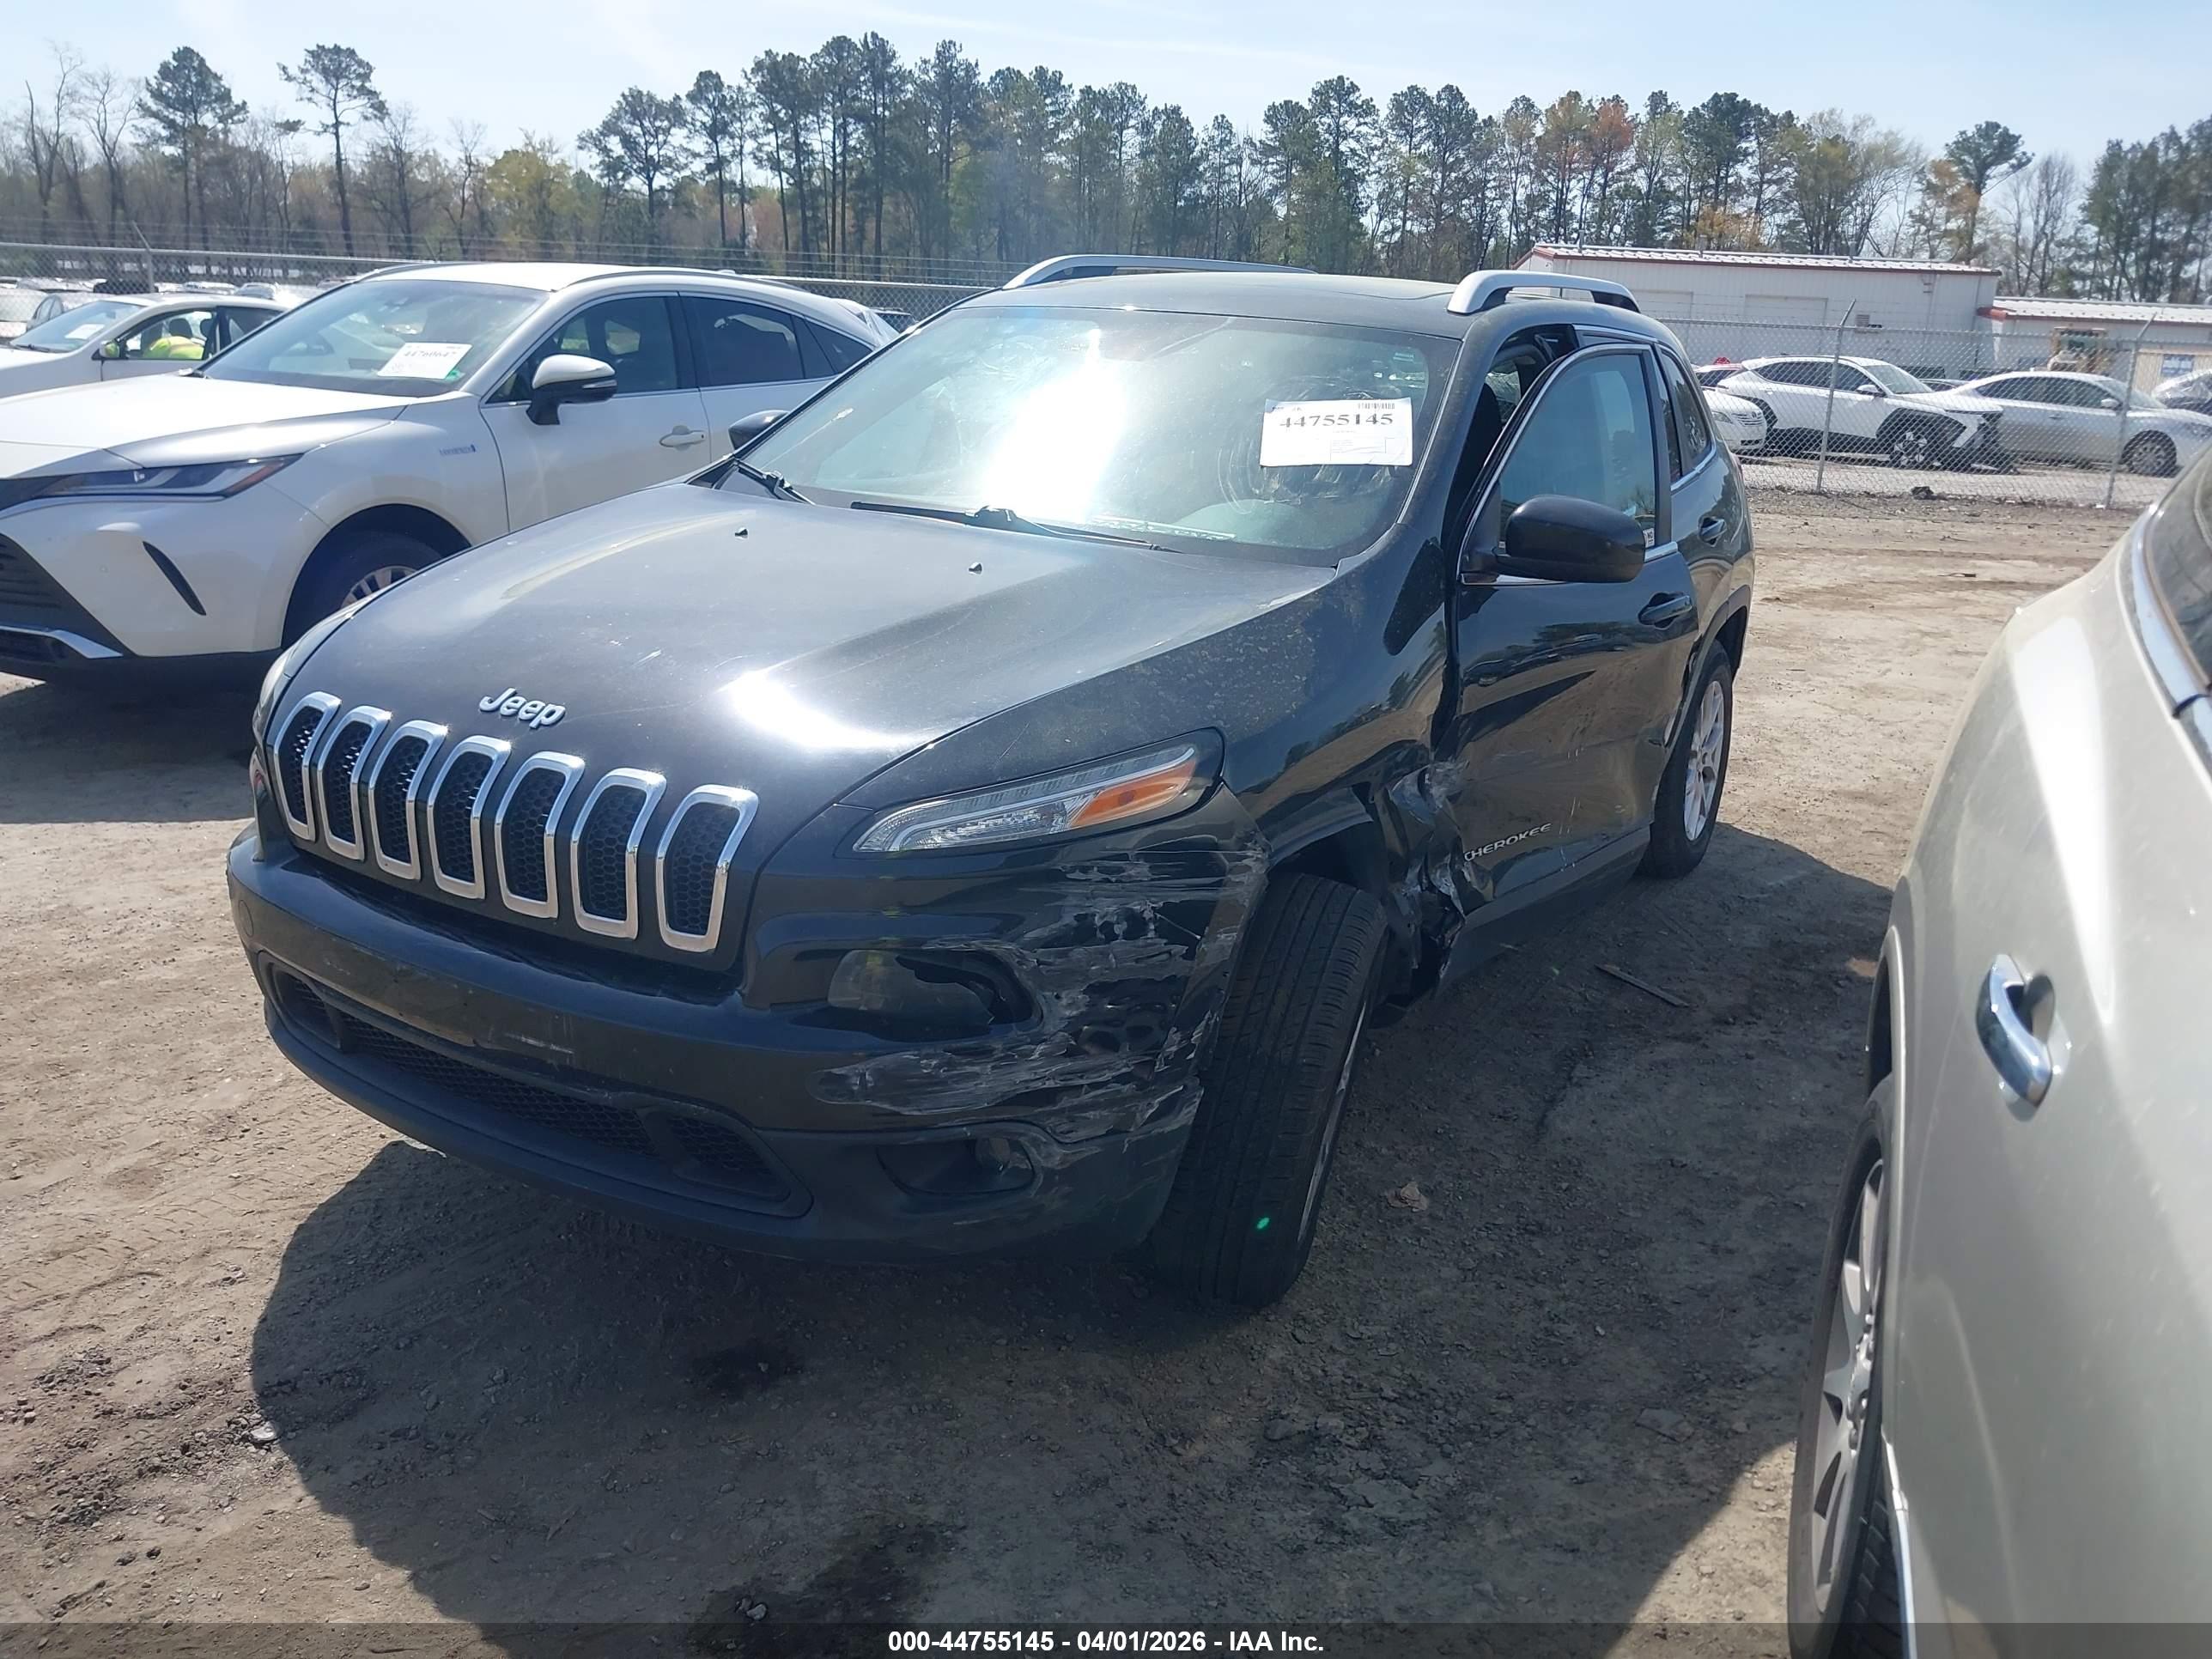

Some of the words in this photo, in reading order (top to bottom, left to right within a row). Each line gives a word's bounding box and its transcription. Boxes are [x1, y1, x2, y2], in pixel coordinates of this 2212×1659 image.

[1279, 413, 1394, 428] 44755145
[479, 687, 567, 730] Jeep
[1464, 823, 1553, 862] CHEROKEE
